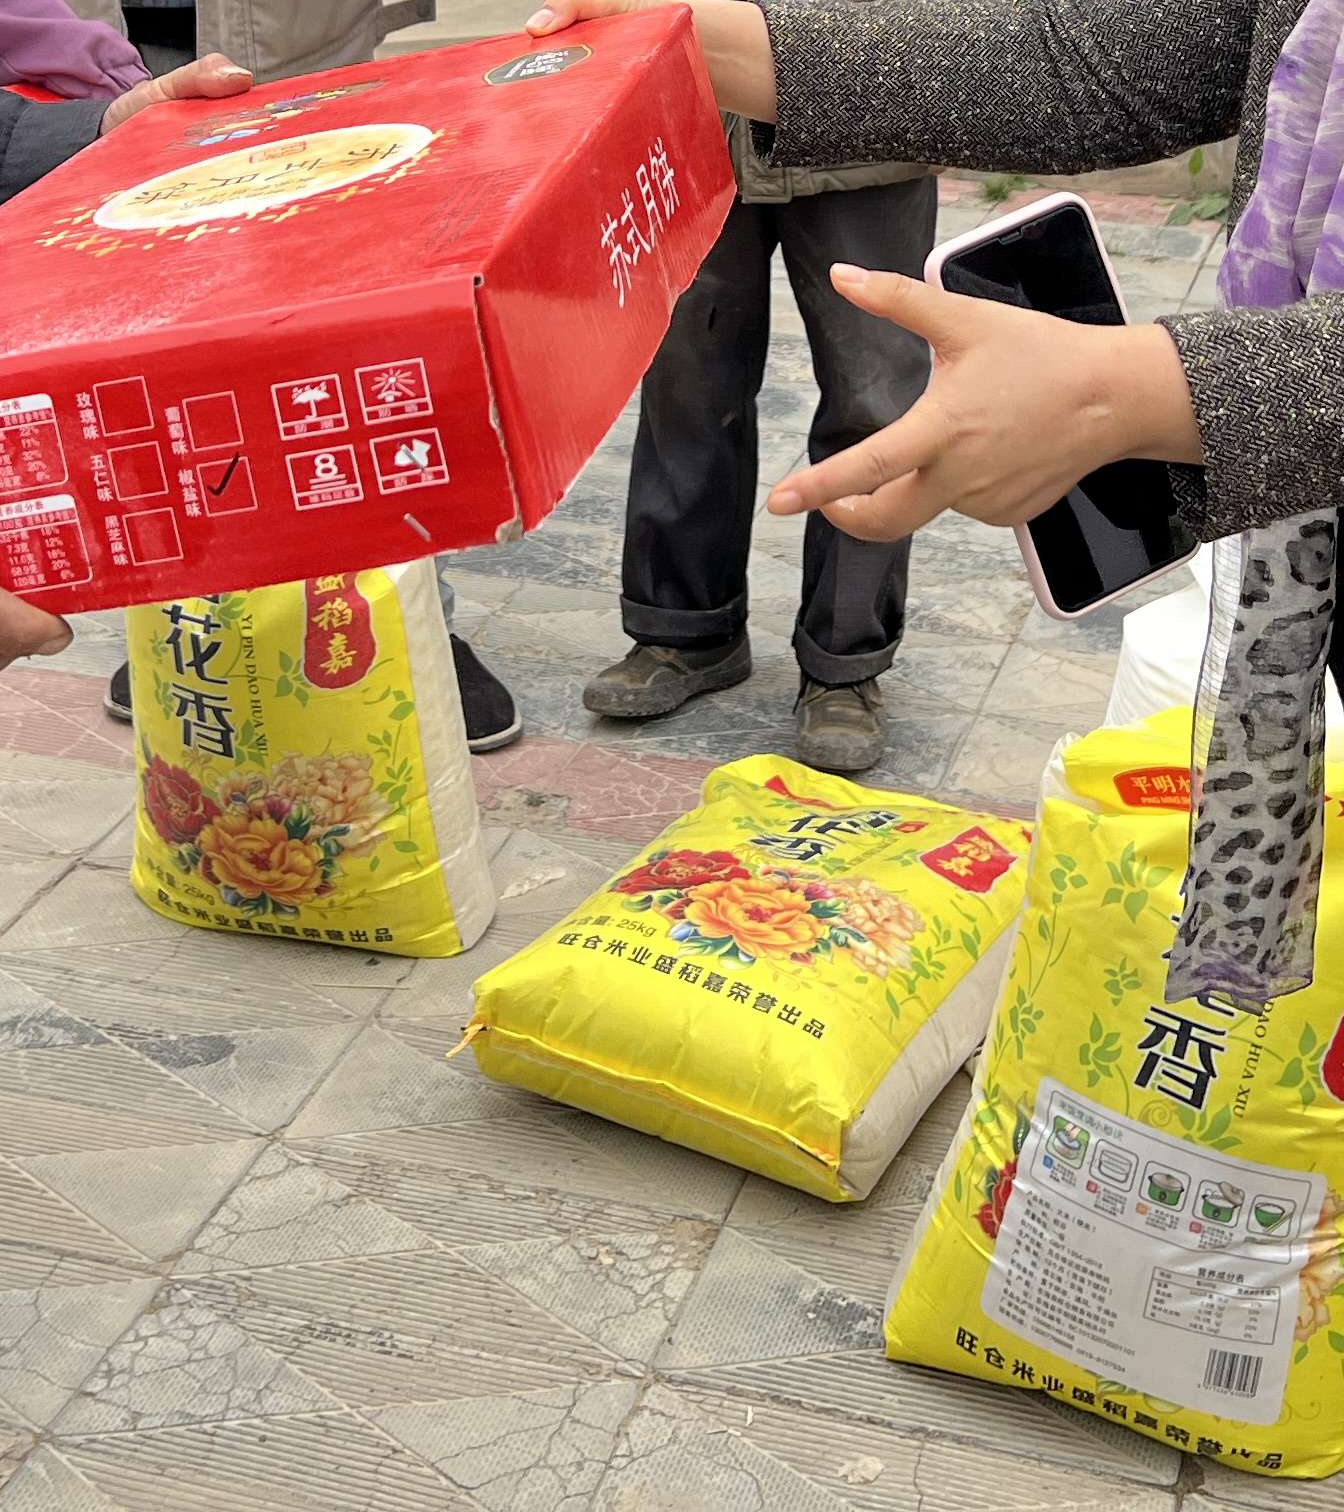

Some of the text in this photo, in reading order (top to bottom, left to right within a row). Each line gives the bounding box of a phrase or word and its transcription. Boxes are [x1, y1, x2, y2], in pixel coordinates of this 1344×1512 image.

[601, 137, 681, 309] 苏式月饼
[76, 392, 99, 440] 玫瑰味
[164, 406, 189, 456] 葡萄味
[90, 454, 114, 502] 五仁味
[178, 469, 202, 518] 椒盐味
[105, 514, 129, 566] 黑芝麻味
[242, 615, 253, 630] YI
[242, 636, 255, 660] PIN
[160, 595, 237, 760] 花香
[245, 663, 260, 695] DAO
[250, 699, 264, 729] HUA
[616, 918, 657, 938] 25kg
[557, 932, 828, 1040] 旺仓米业盛稻嘉荣誉出品
[1233, 1001, 1275, 1119] DAO HUA XIU
[1198, 1267, 1245, 1283] 营养成分表
